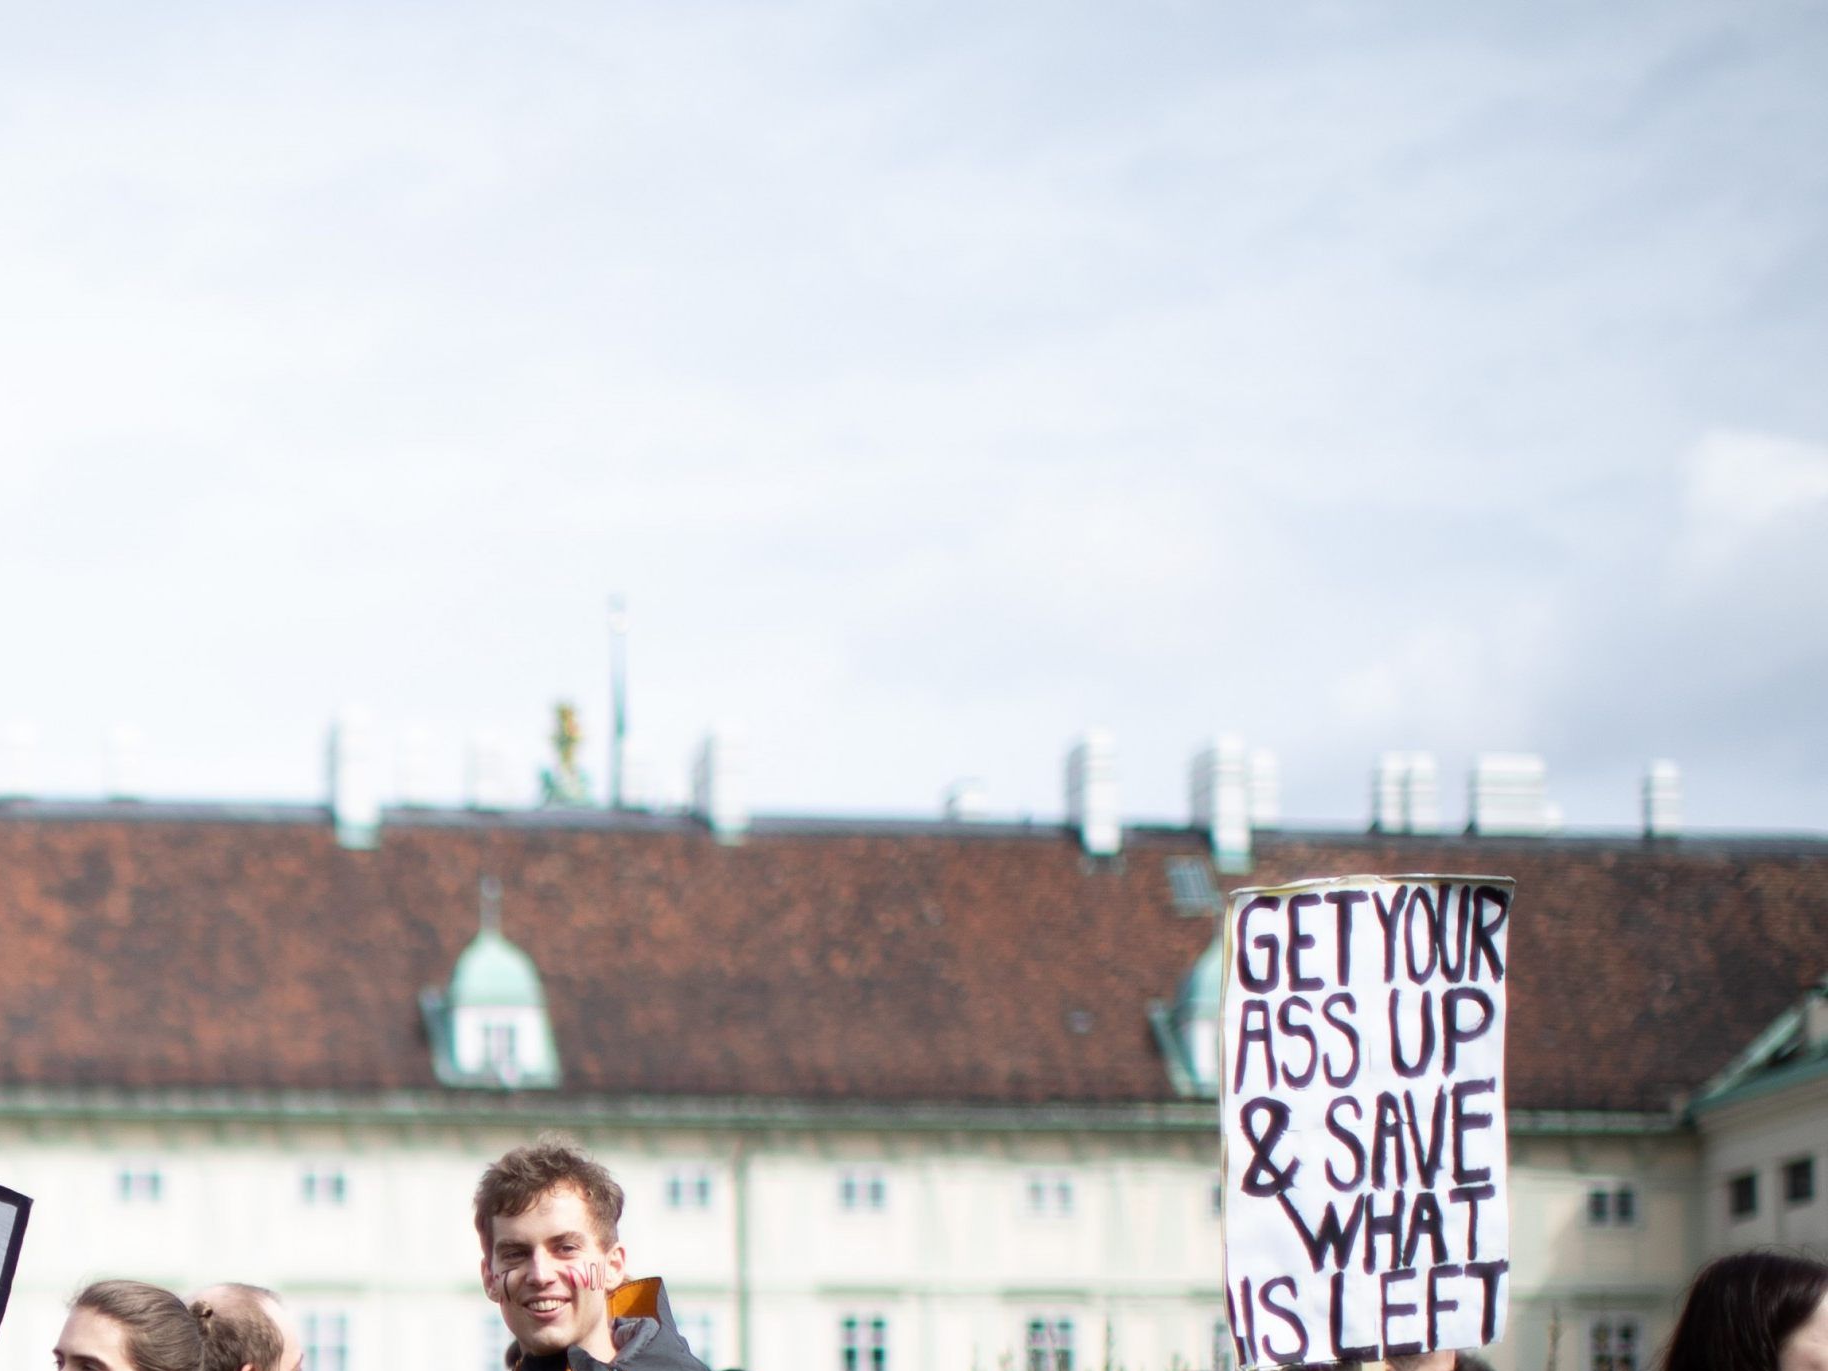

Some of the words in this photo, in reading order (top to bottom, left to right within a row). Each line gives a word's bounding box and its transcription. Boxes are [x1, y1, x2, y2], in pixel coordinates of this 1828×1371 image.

[1237, 890, 1370, 994] GET
[1372, 885, 1510, 986] YOUR
[1234, 991, 1361, 1094] ASS
[1388, 986, 1495, 1080] UP
[1240, 1096, 1301, 1198] &
[1324, 1077, 1496, 1193] SAVE
[1276, 1184, 1496, 1274] WHAT
[1329, 1260, 1510, 1362] LEFT
